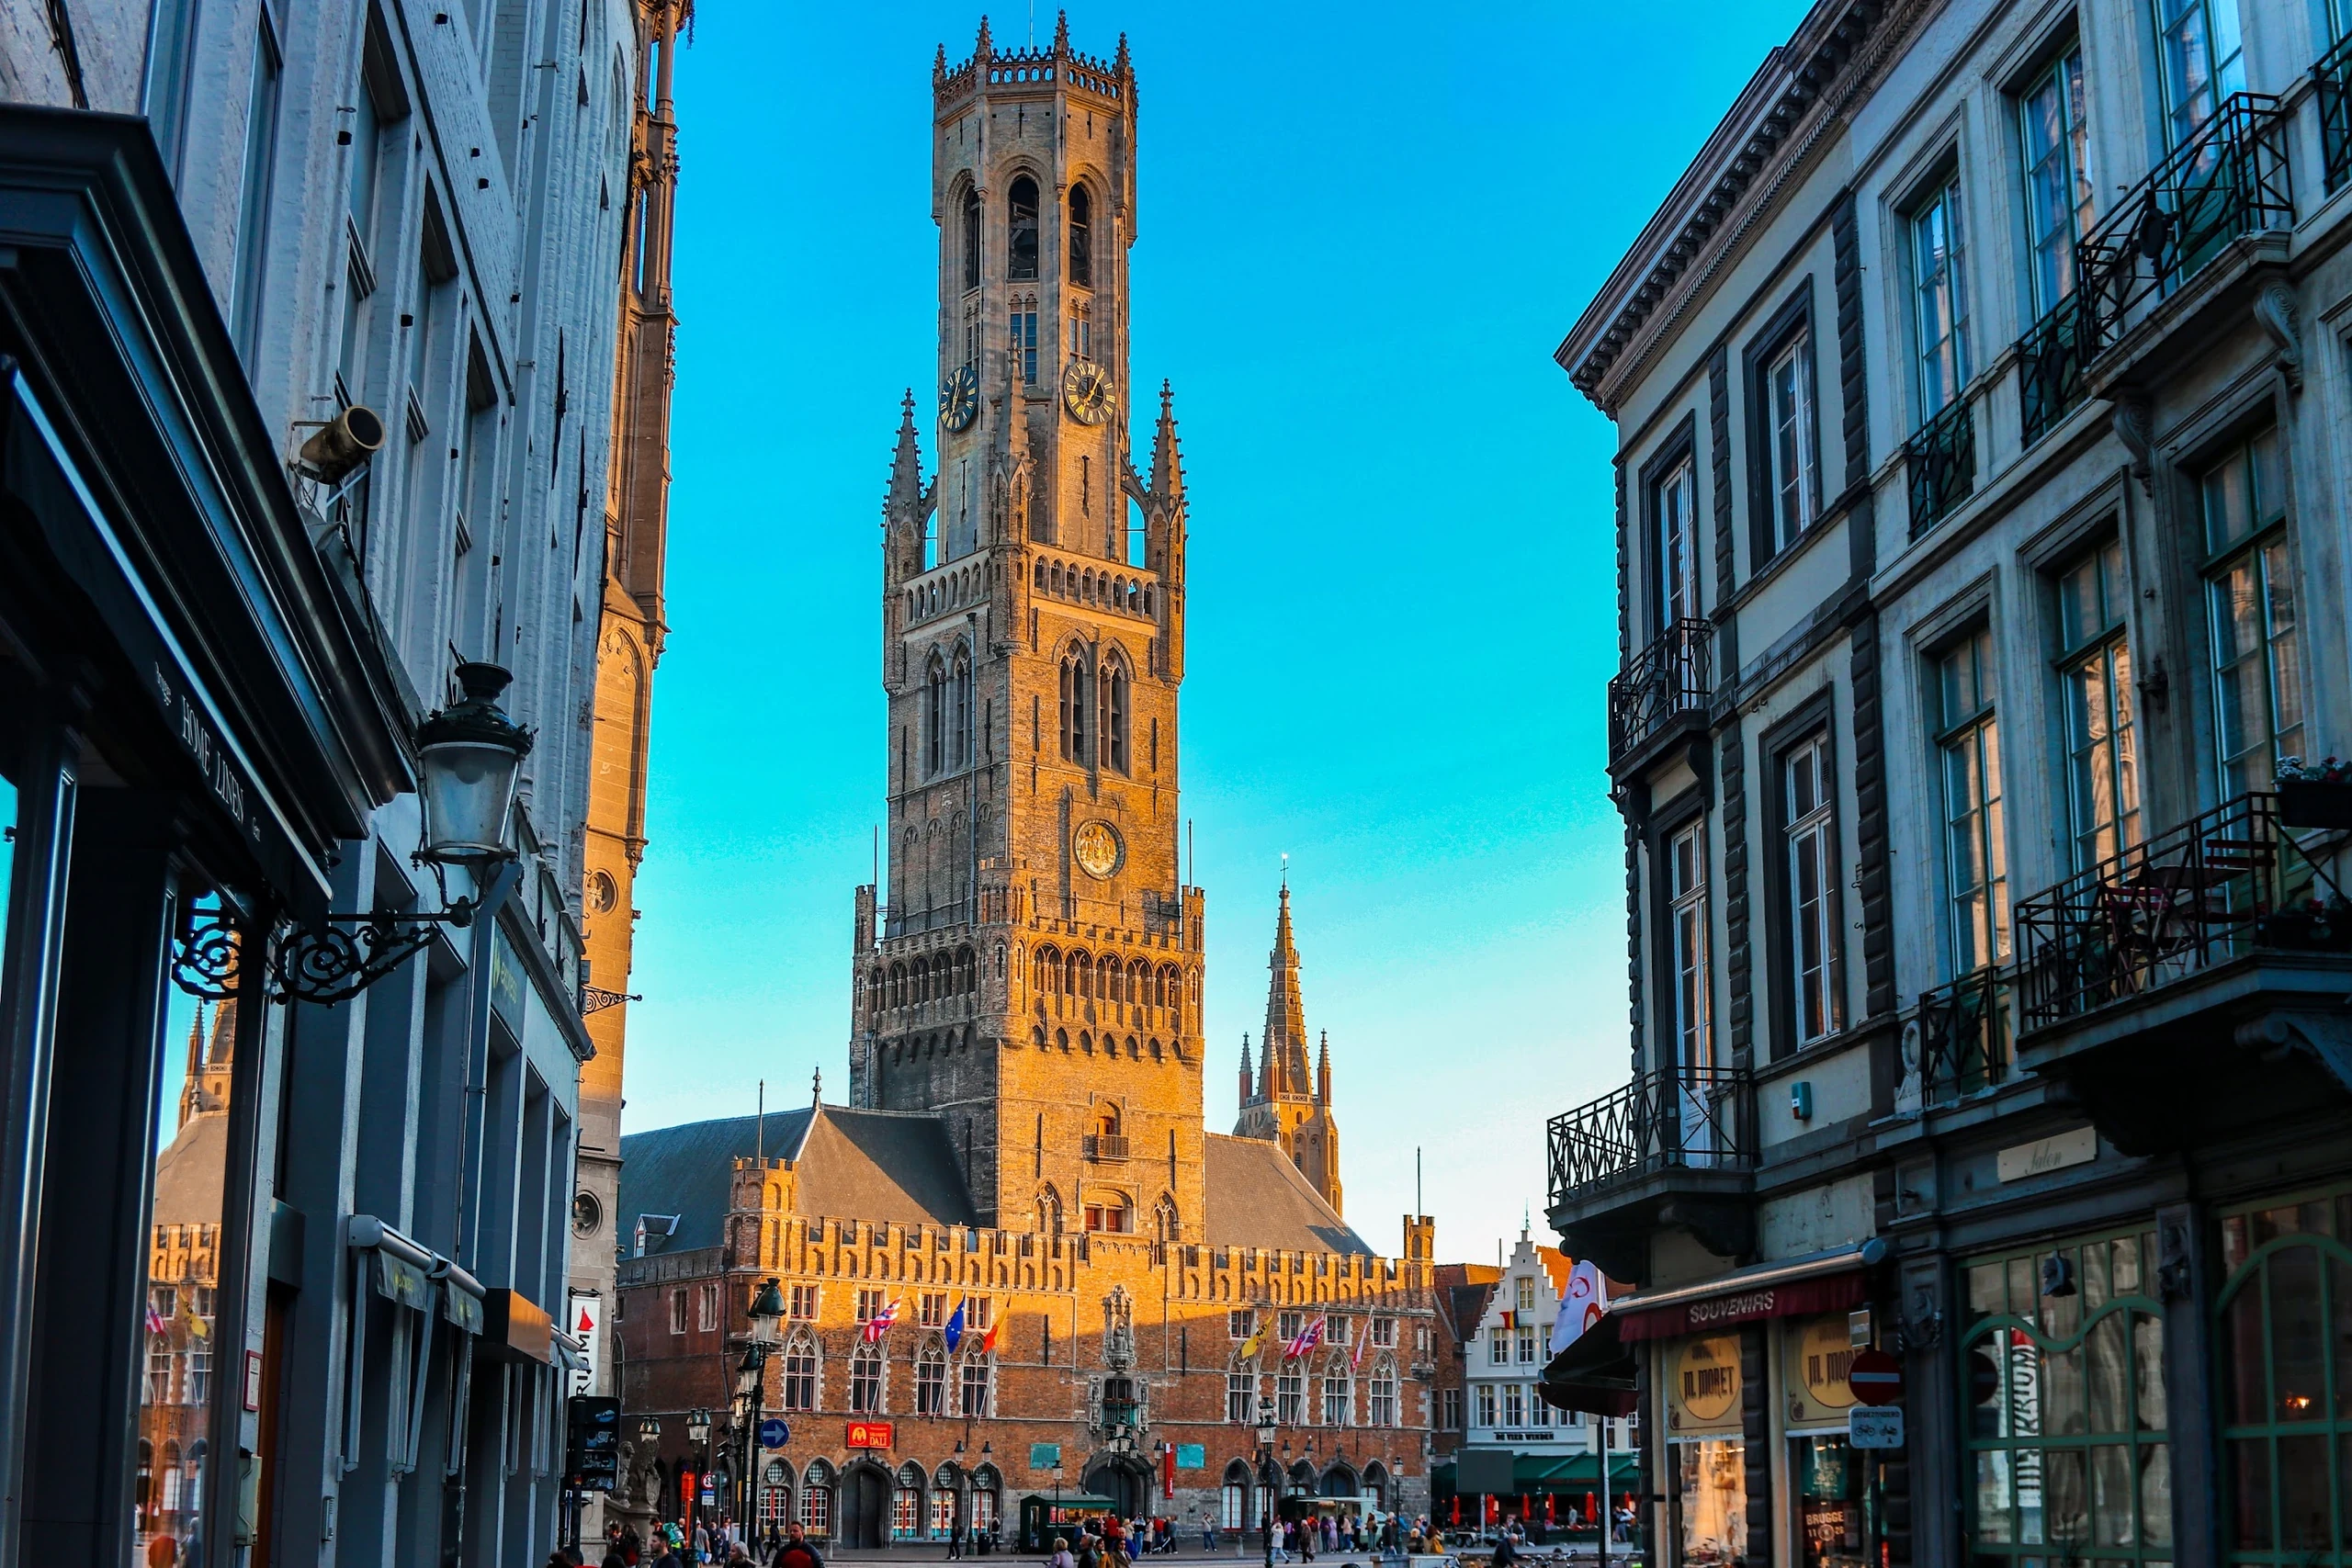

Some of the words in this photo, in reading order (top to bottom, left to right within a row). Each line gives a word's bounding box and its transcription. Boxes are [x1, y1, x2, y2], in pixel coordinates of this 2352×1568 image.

[1069, 370, 1080, 382] X
[1066, 382, 1077, 392] IX
[1103, 382, 1114, 390] II
[1097, 411, 1105, 423] V
[182, 694, 211, 777] HOME
[215, 750, 244, 824] LINEN
[1690, 1291, 1774, 1324] SOUVENIRS
[1698, 1366, 1734, 1400] MORET
[1805, 1511, 1845, 1525] BRUGGE
